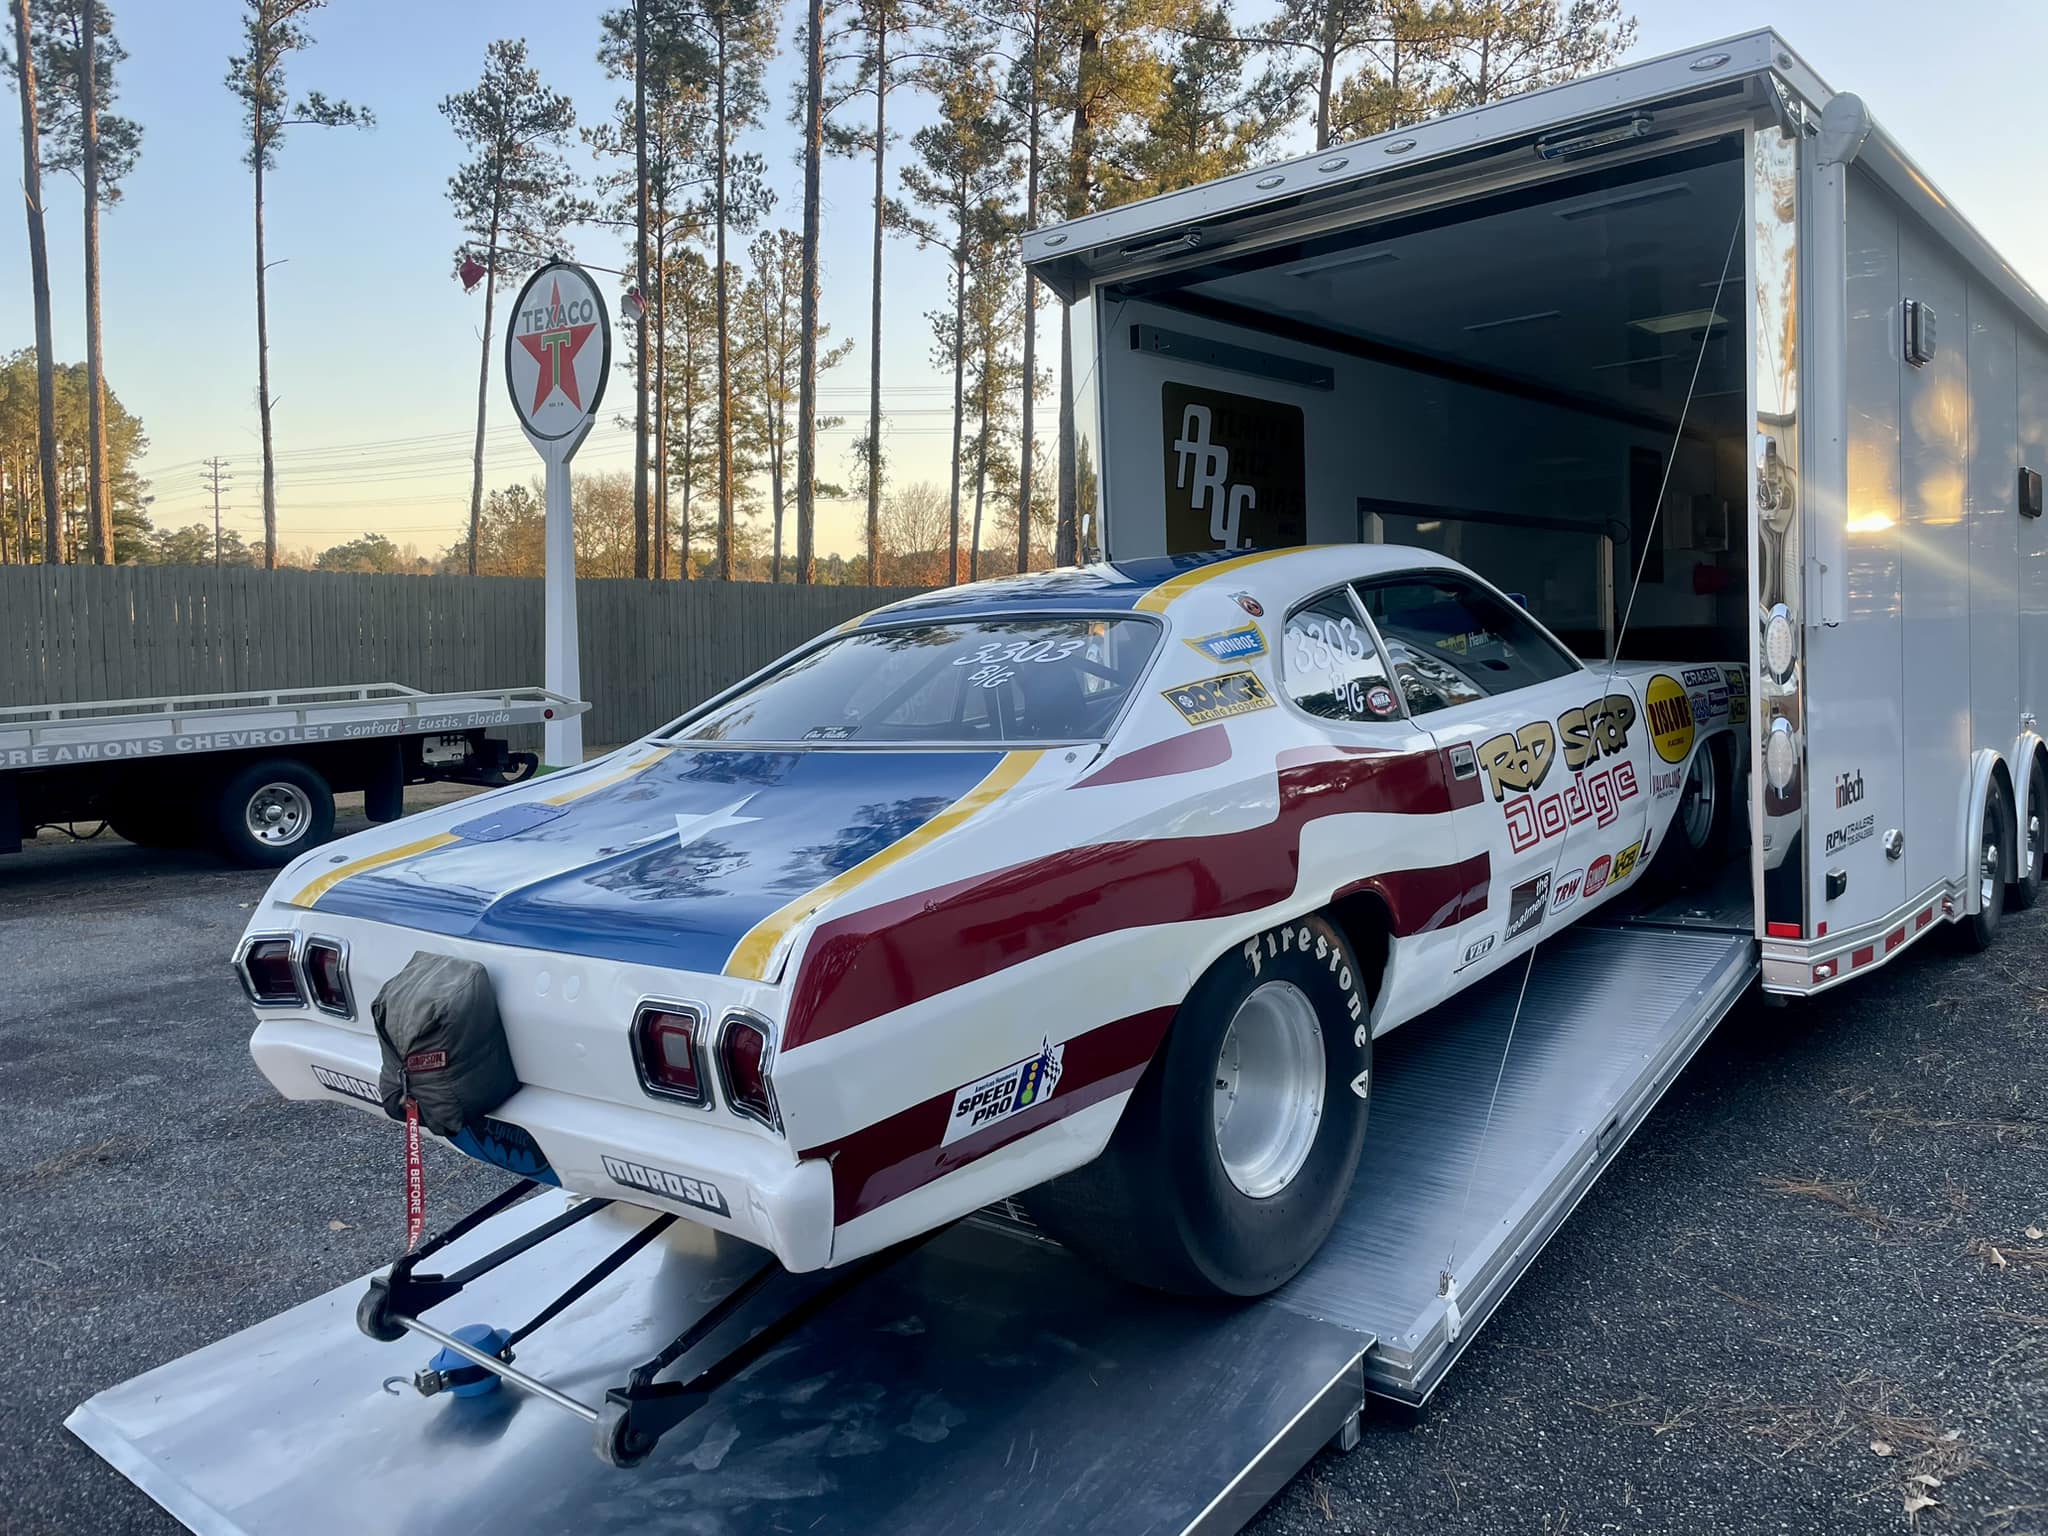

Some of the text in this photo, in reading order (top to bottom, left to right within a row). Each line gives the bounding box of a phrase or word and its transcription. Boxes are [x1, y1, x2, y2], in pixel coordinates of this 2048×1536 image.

[522, 298, 593, 333] TEXACO
[953, 640, 1087, 666] 3303
[1209, 635, 1258, 655] MONROE
[1288, 616, 1364, 673] 3303
[1684, 669, 1719, 686] CRAGAR
[1191, 698, 1272, 721] RACING PRODUCTS
[0, 738, 164, 766] REAMONS
[175, 725, 332, 751] CHEVROLET
[343, 718, 398, 737] Sanford
[418, 715, 462, 731] Eustis,
[467, 711, 510, 726] Florida
[1476, 694, 1637, 802] ROD SHOP
[1503, 760, 1639, 854] Dodge
[1836, 768, 1864, 809] inTech
[1825, 826, 1847, 851] RPM
[1847, 814, 1874, 835] TRAILERS
[1536, 875, 1549, 897] the
[1552, 877, 1582, 905] TRW
[1505, 887, 1549, 939] treatment
[1470, 937, 1492, 959] VHT
[1244, 926, 1366, 1048] Firestone
[956, 1077, 1018, 1118] SPEED
[971, 1096, 1012, 1126] PRO
[409, 1117, 419, 1165] REMOVE
[410, 1168, 422, 1214] BEFORE
[603, 1156, 721, 1209] MOROSO
